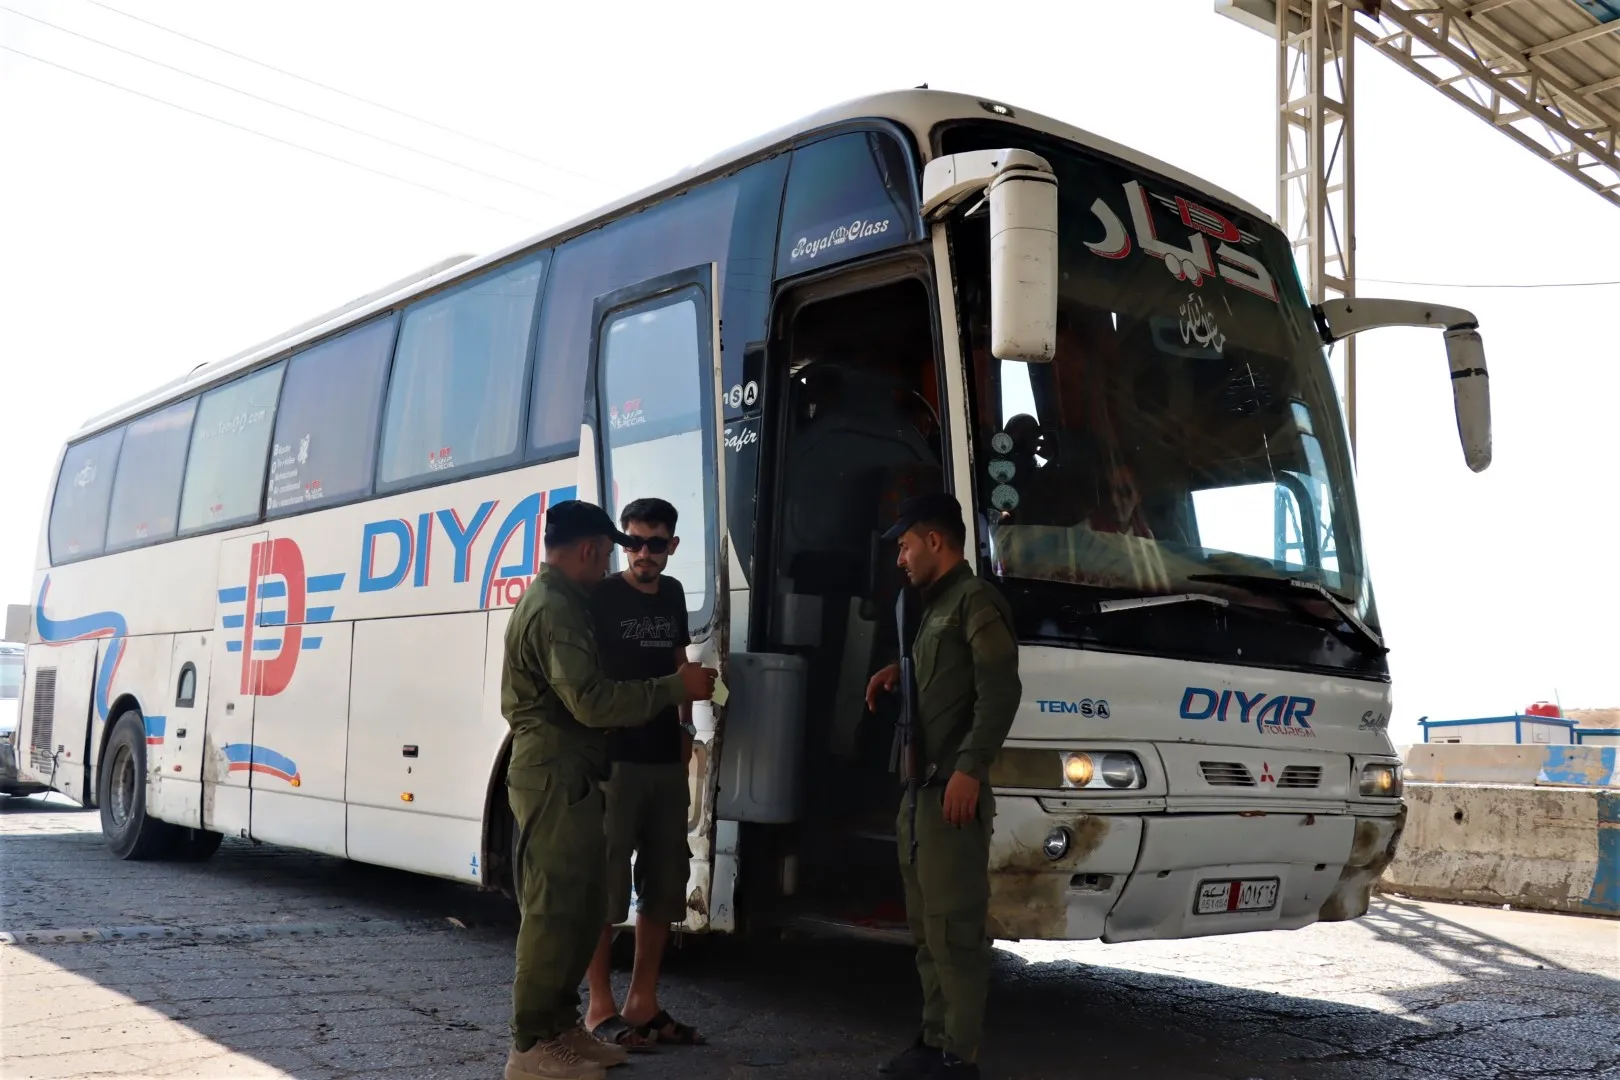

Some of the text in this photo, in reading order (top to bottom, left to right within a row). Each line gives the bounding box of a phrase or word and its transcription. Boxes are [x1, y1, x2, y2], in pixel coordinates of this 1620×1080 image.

[791, 219, 890, 259] Royal Class
[1083, 179, 1280, 304] ديار
[724, 427, 758, 453] Safir
[358, 484, 578, 610] DIYA
[1036, 698, 1111, 719] TEMSA
[1179, 686, 1317, 735] DIYAR
[1263, 724, 1316, 738] TOURISM
